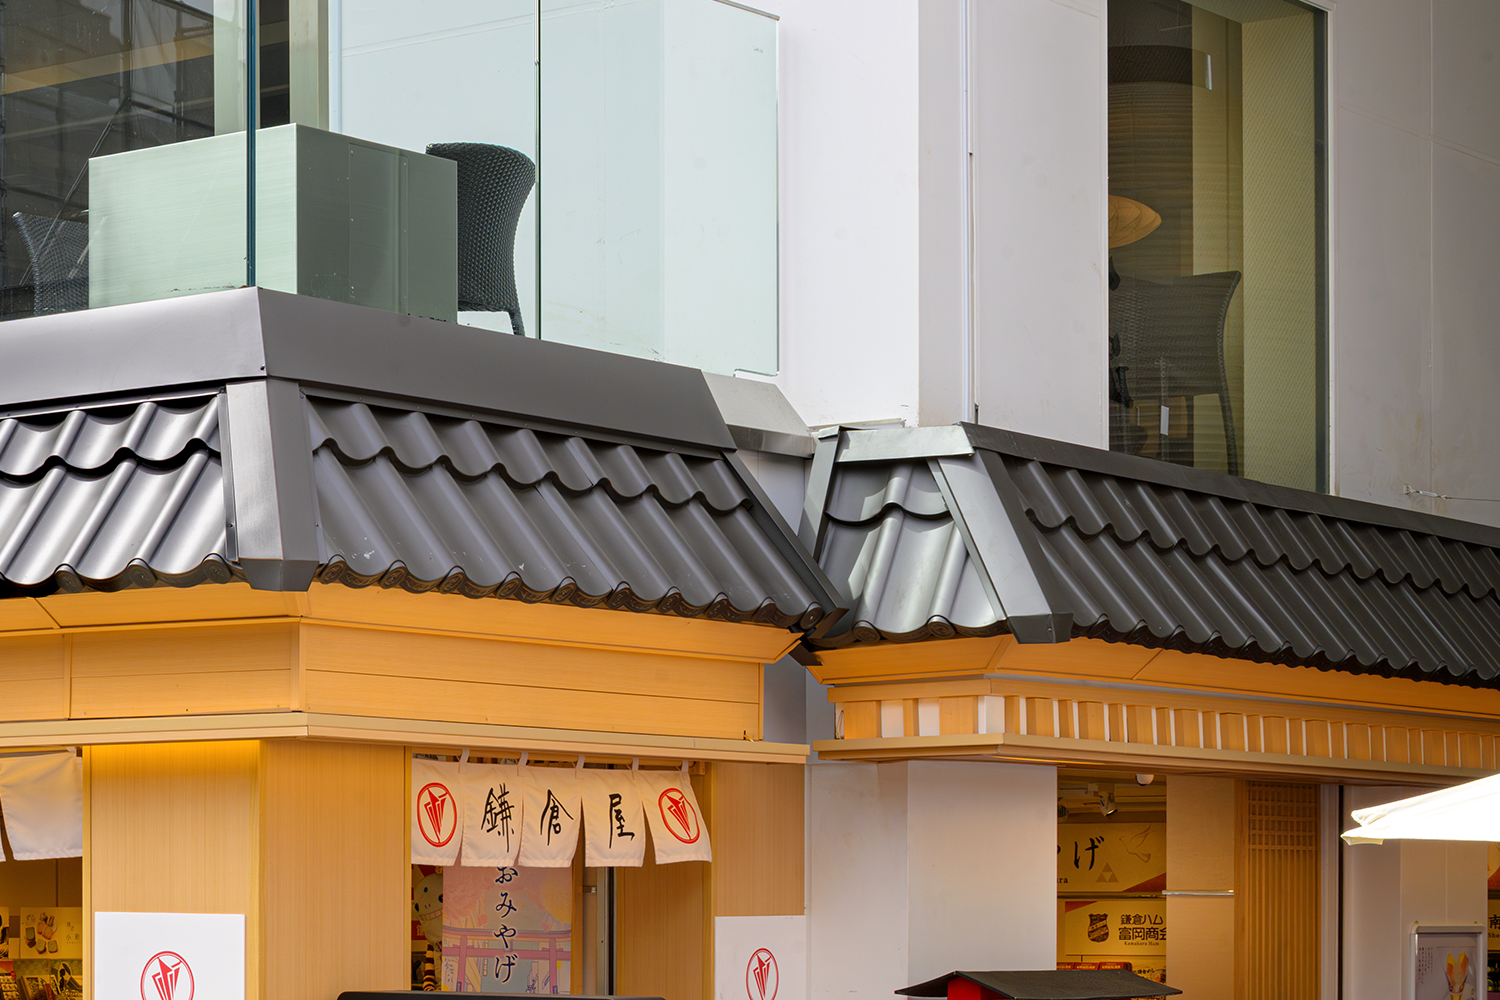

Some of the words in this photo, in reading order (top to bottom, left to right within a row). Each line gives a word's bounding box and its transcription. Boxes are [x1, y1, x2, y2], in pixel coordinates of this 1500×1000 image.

[480, 782, 636, 854] 鎌倉屋
[492, 865, 520, 984] おみやげ
[1120, 913, 1164, 926] 鎌倉ハム
